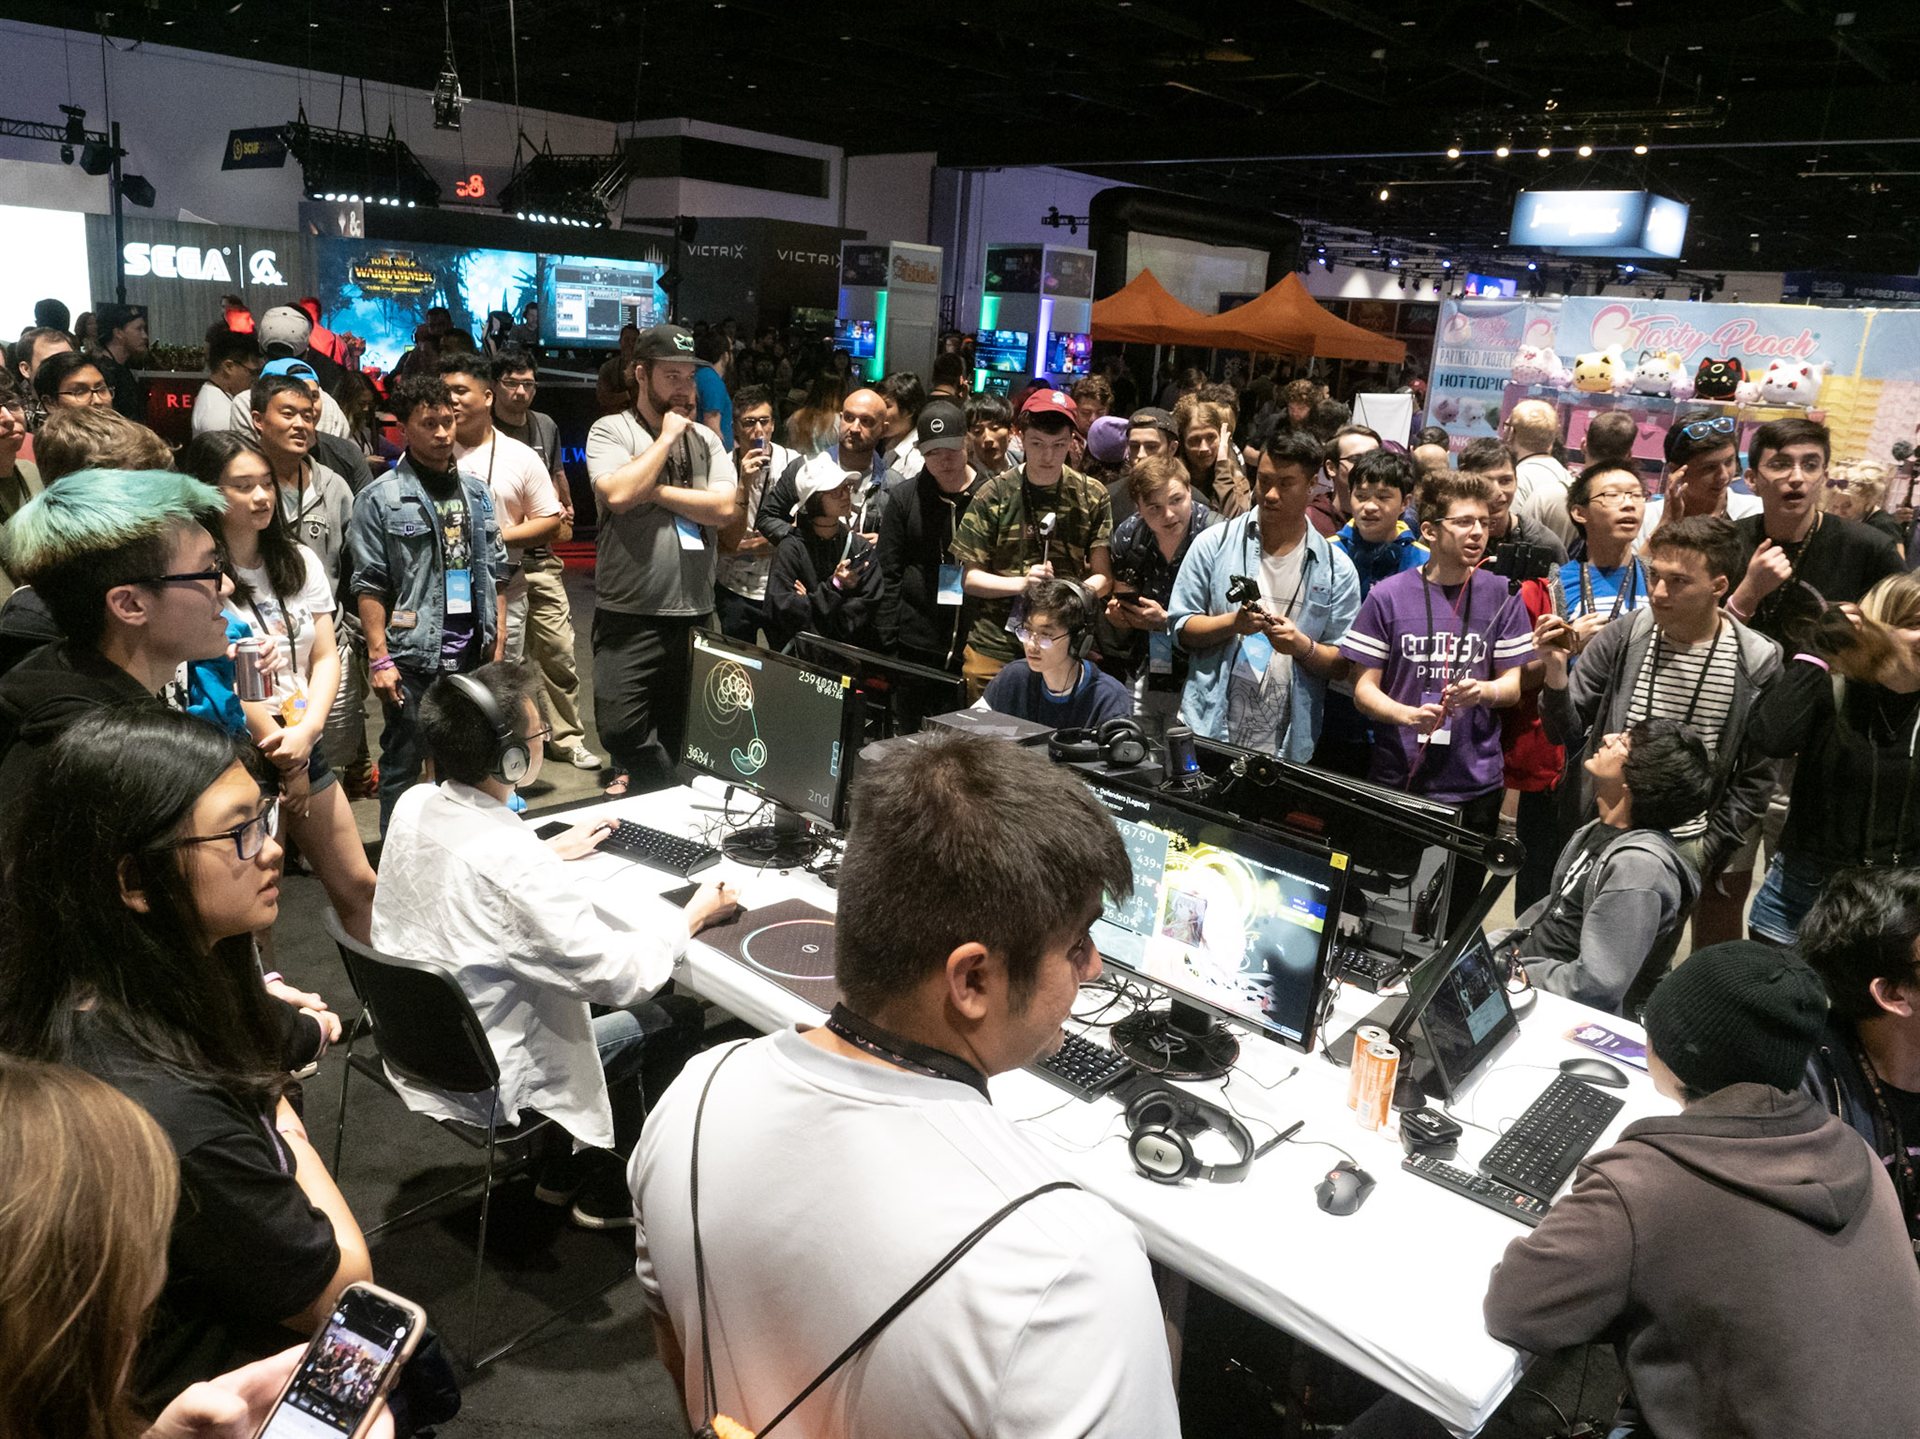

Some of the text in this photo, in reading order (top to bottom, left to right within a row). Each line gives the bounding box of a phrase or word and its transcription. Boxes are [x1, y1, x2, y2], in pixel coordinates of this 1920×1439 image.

[687, 244, 744, 259] VICTRIX
[123, 242, 232, 282] SEGA
[354, 266, 434, 282] WARHAMMER
[1628, 313, 1820, 361] Tasty Peach
[1439, 374, 1467, 388] HOT
[807, 789, 831, 808] 2nd
